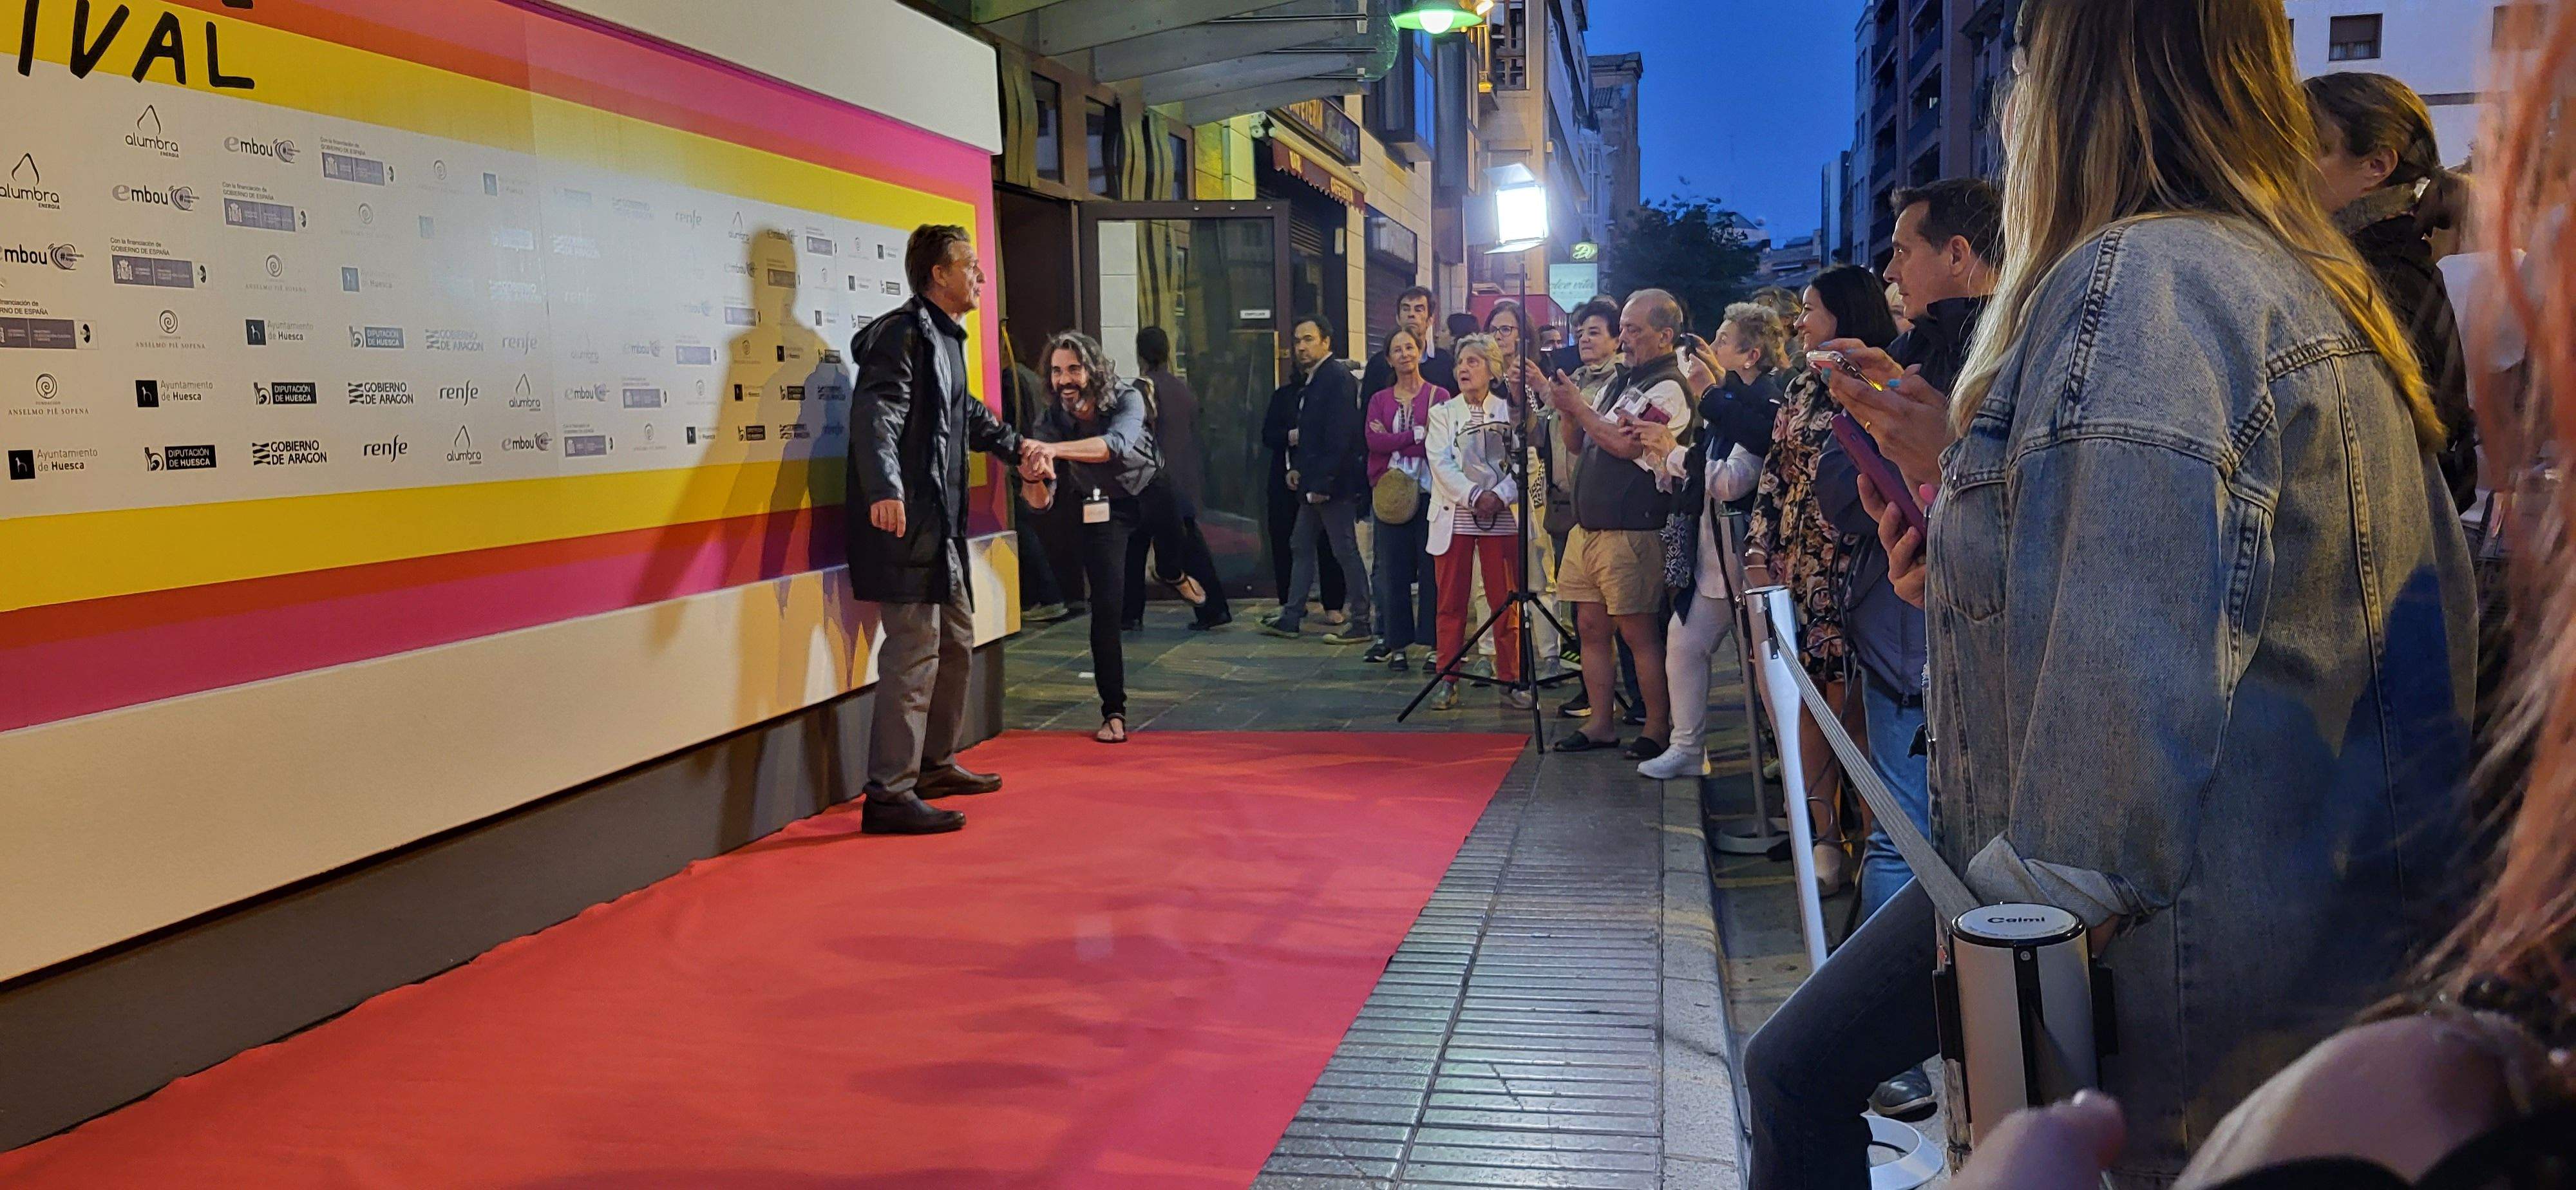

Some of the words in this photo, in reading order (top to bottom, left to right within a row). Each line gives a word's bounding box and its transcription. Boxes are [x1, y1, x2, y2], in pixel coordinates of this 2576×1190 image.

[125, 132, 179, 152] alumbra
[223, 137, 273, 157] embou
[0, 184, 60, 203] alumbra
[112, 185, 168, 205] embou
[127, 238, 155, 247] financiación
[0, 244, 47, 265] mbou
[111, 245, 140, 254] GOBIERNO
[268, 332, 276, 340] de
[278, 331, 303, 341] Huesca
[502, 330, 537, 354] renfe
[440, 341, 451, 350] DE
[160, 379, 213, 392] Ayuntamiento
[274, 384, 311, 393] DIPUTACIÓN
[364, 382, 407, 393] GOBIERNO
[161, 392, 171, 401] de
[173, 392, 202, 401] Huesca
[275, 394, 284, 402] DE
[285, 394, 311, 402] HUESCA
[365, 393, 377, 404] DE
[379, 393, 413, 405] ARAGON
[439, 380, 478, 406] renfe
[565, 386, 594, 401] embou
[509, 397, 541, 408] alumbra
[270, 440, 319, 452] GOBIERNO
[364, 435, 408, 462] renfe
[501, 435, 535, 451] embou
[37, 448, 98, 461] Ayuntamiento
[168, 447, 209, 458] DIPUTACIÓN
[272, 453, 285, 465] DE
[288, 451, 327, 465] ARAGON
[446, 449, 482, 462] alumbra
[38, 462, 48, 472] de
[52, 461, 85, 471] Huesca
[169, 459, 179, 468] DE
[180, 458, 211, 467] HUESCA
